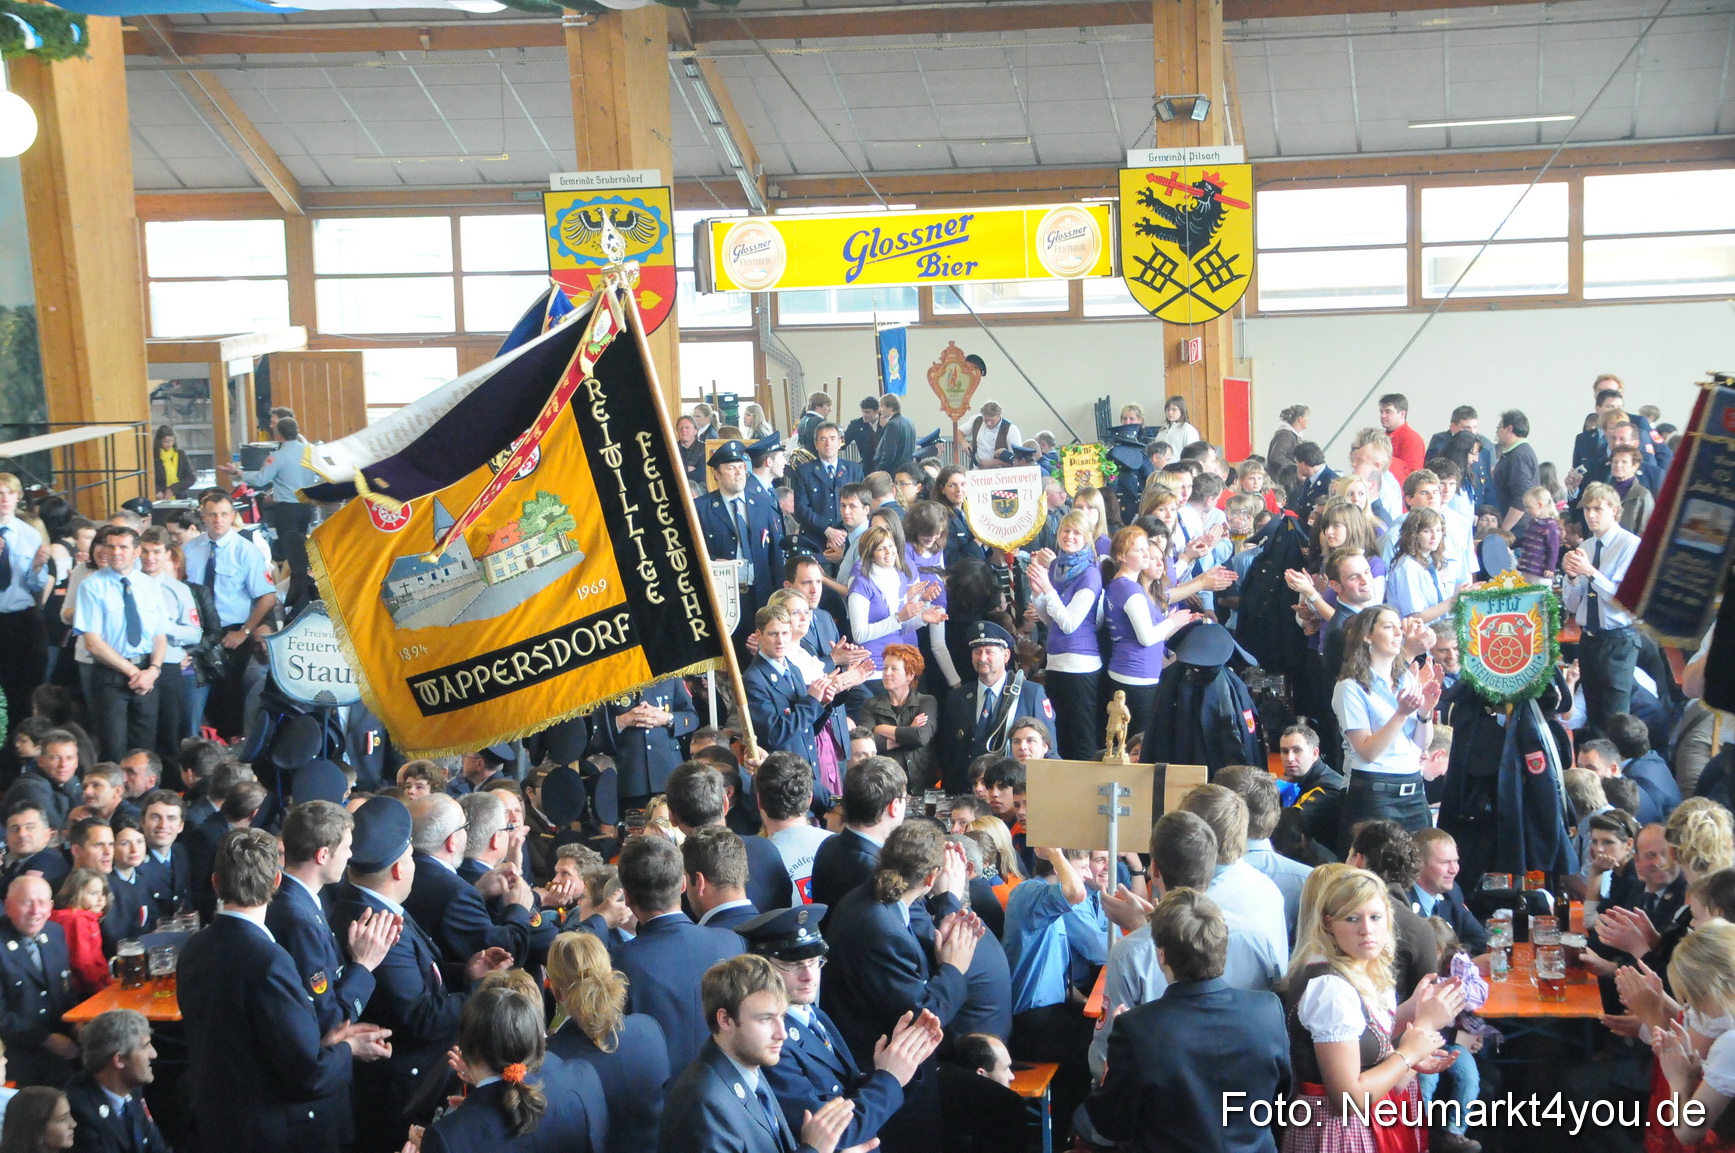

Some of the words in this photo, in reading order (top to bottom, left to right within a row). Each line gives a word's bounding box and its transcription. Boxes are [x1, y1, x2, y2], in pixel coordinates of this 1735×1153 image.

[1148, 152, 1186, 163] Gemeinde
[1188, 151, 1220, 162] Pilsach
[559, 176, 594, 186] Gemeinde
[596, 173, 644, 185] Seubersdorf
[842, 213, 975, 284] Glossner
[1047, 226, 1088, 250] Glossner
[733, 240, 772, 263] Glossner
[916, 251, 979, 279] Bier
[1069, 457, 1098, 467] Pilsach
[995, 471, 1039, 487] Feuerwehr
[634, 430, 710, 642] FEUERWEHR
[577, 578, 608, 600] 1969
[398, 643, 429, 662] 1894
[1471, 659, 1543, 689] RENGERSRICHT
